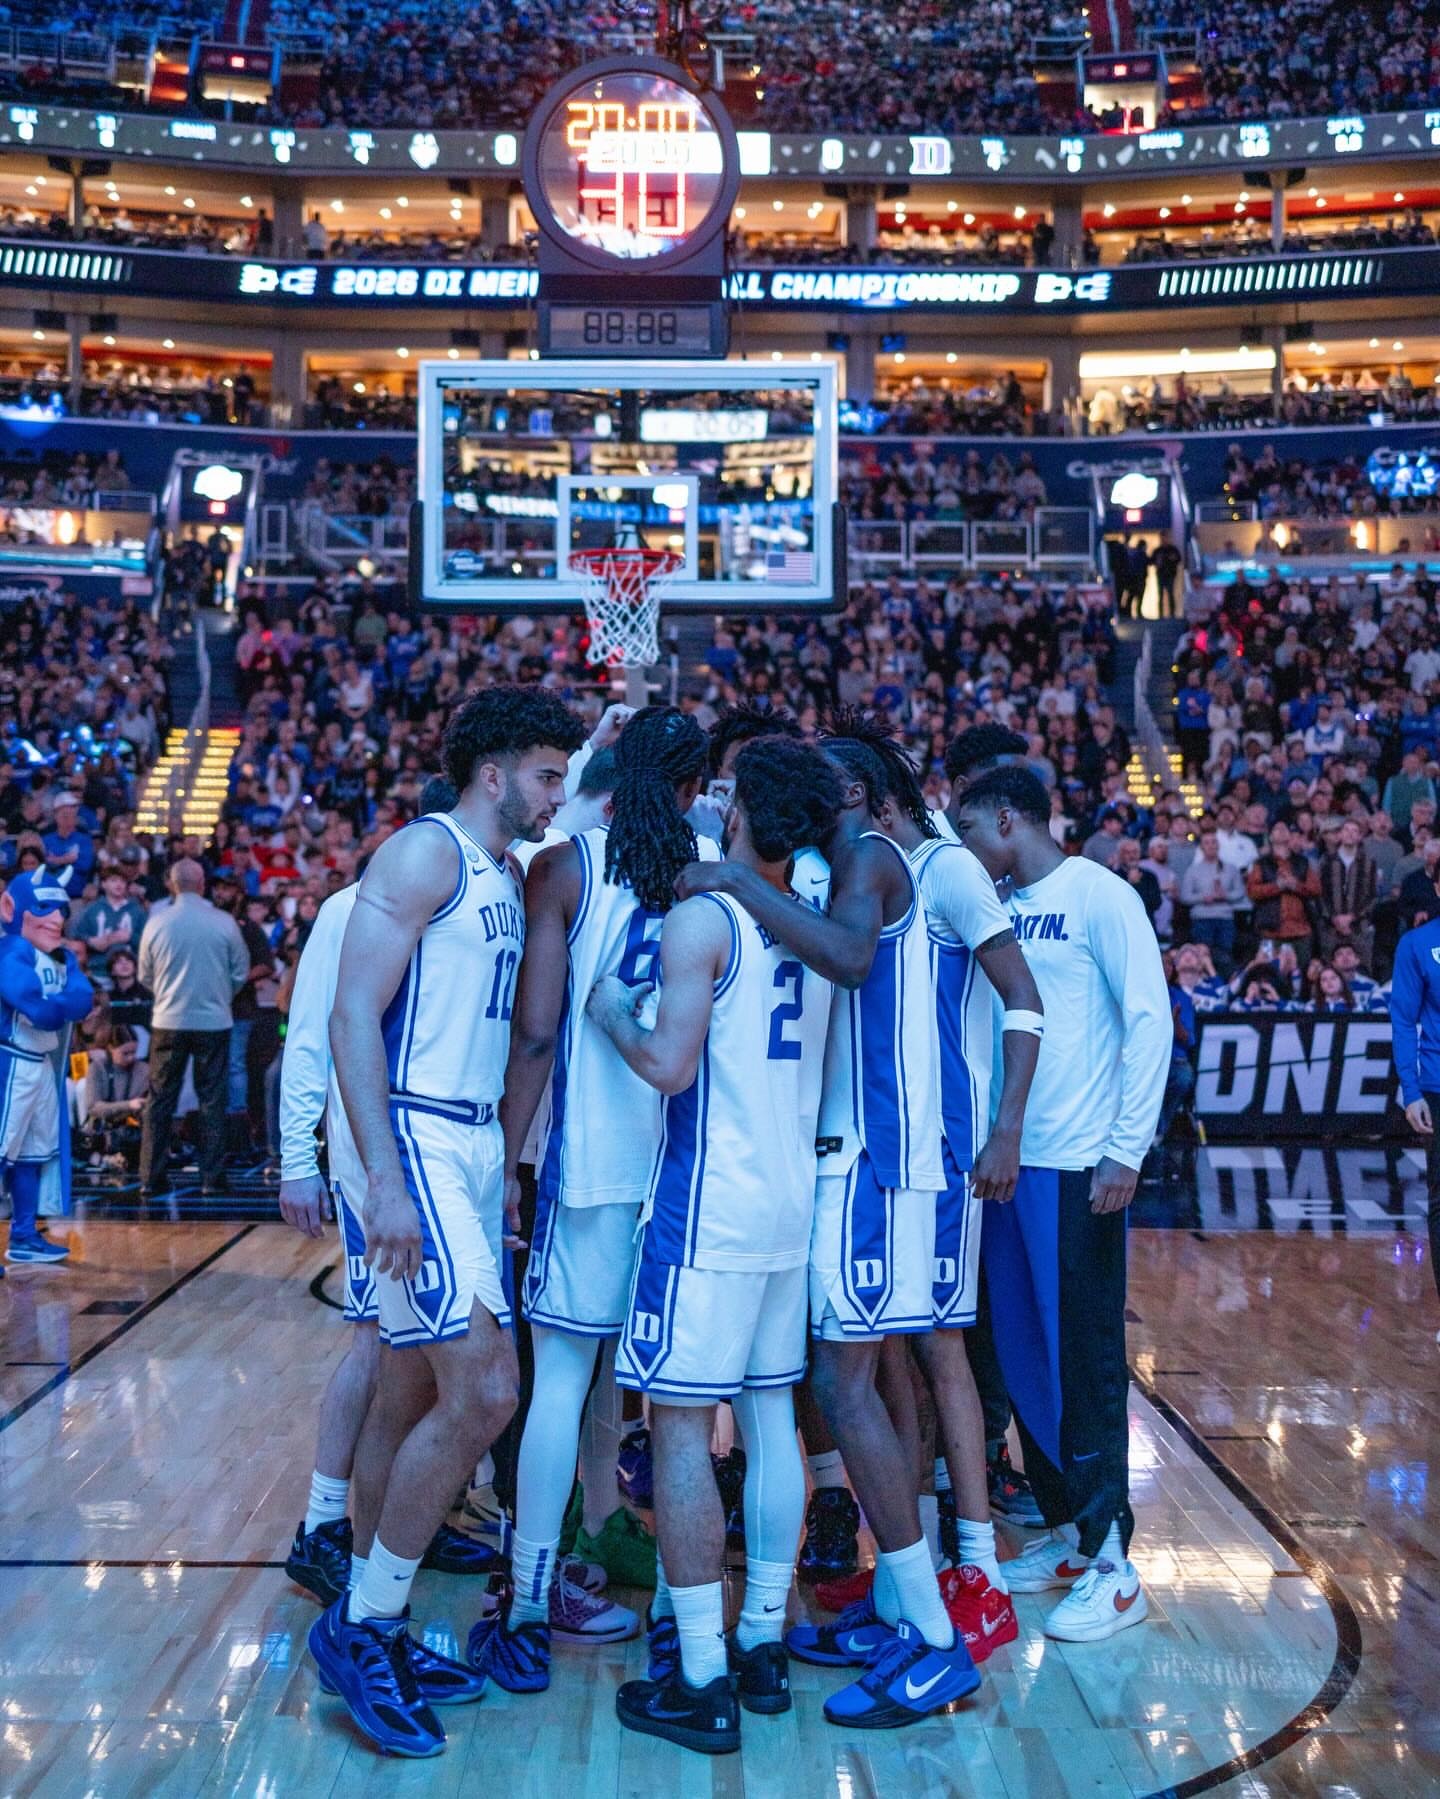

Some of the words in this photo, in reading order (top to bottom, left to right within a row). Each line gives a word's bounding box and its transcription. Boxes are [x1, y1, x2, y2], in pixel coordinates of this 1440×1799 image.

[1425, 112, 1440, 128] FT
[494, 134, 517, 165] 0
[822, 138, 844, 170] 0
[333, 269, 419, 296] 2026
[423, 270, 465, 296] DI
[770, 273, 1020, 302] CHAMPIONSHIP
[584, 311, 677, 345] 88:88
[485, 948, 518, 1021] 12
[767, 960, 804, 1060] 2
[853, 1258, 884, 1289] D
[631, 1310, 661, 1344] D
